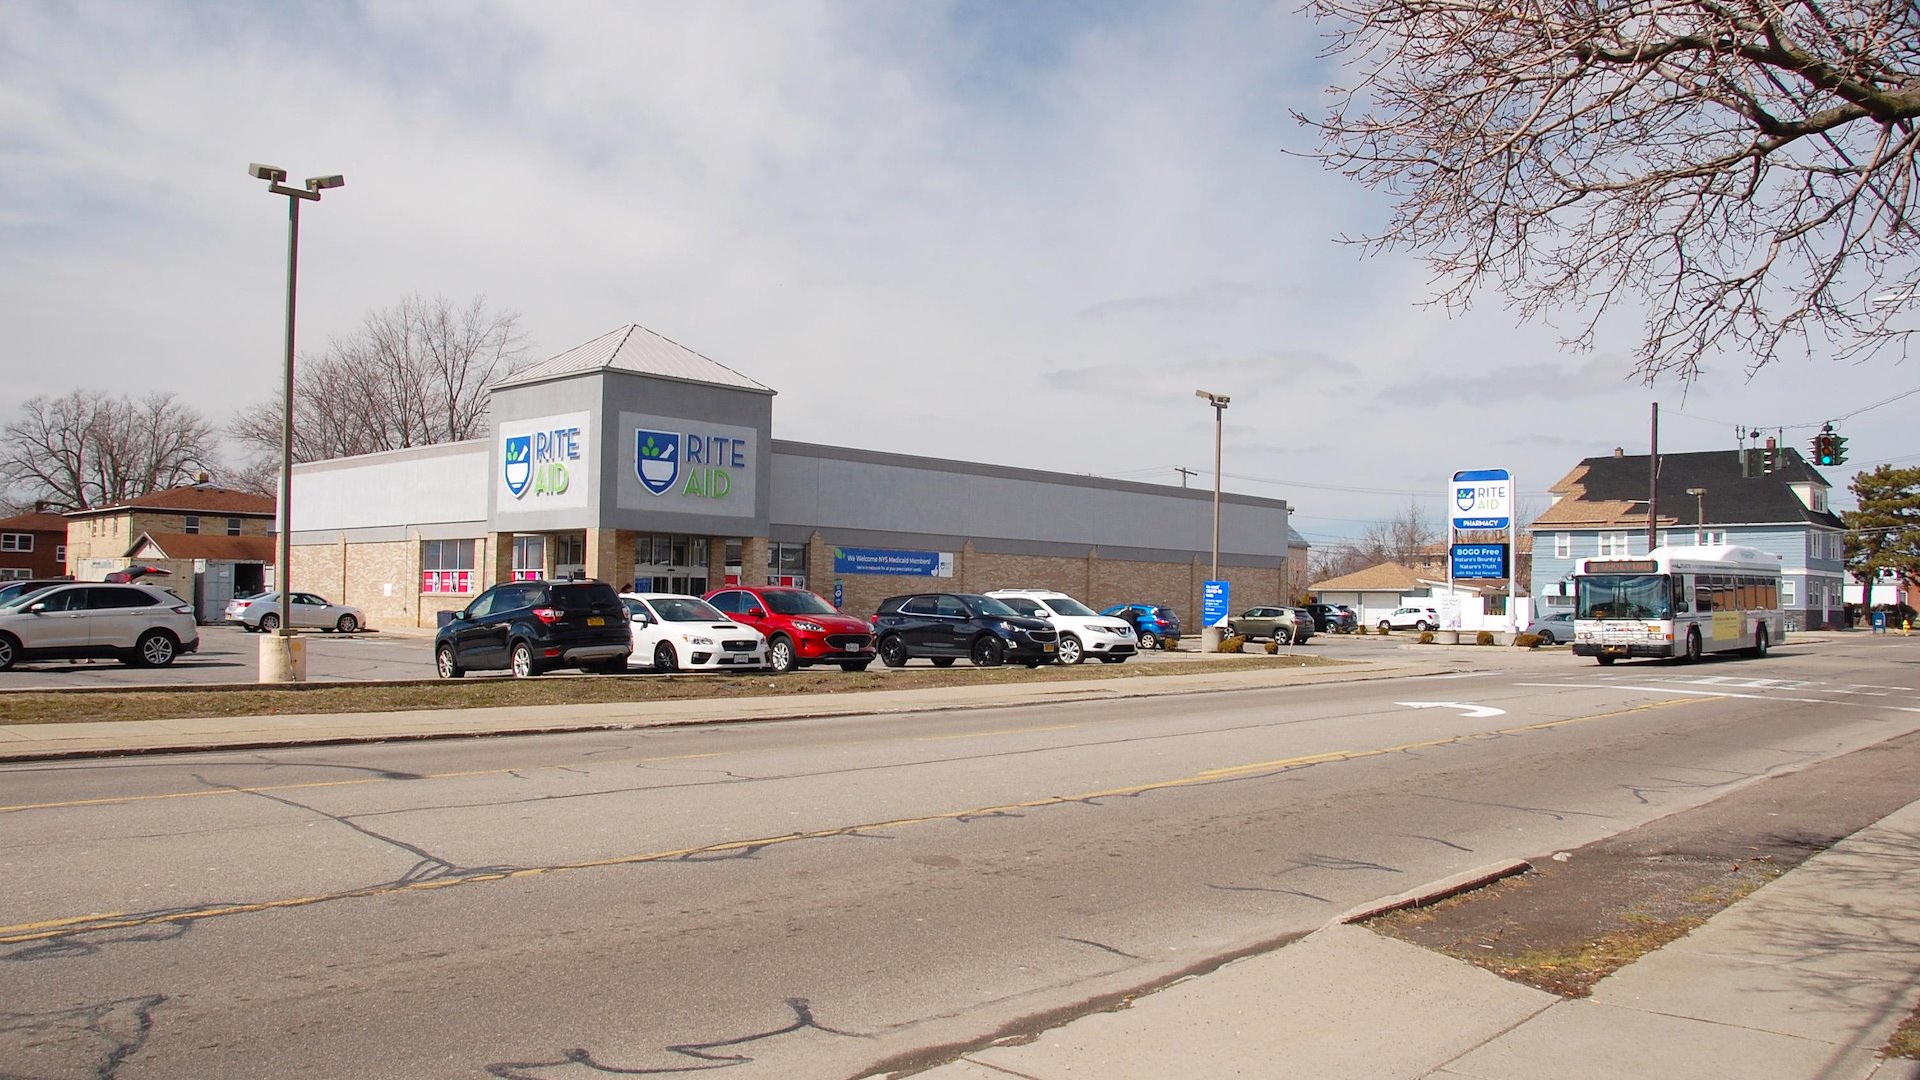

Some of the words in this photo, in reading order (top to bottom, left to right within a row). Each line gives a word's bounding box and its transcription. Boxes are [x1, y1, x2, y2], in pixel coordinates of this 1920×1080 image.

[536, 427, 580, 461] RITE
[685, 433, 746, 468] RITE
[534, 463, 570, 496] AID
[682, 467, 732, 499] AID
[1478, 487, 1505, 498] RITE
[1478, 499, 1499, 510] AID
[889, 556, 909, 564] Medicaid
